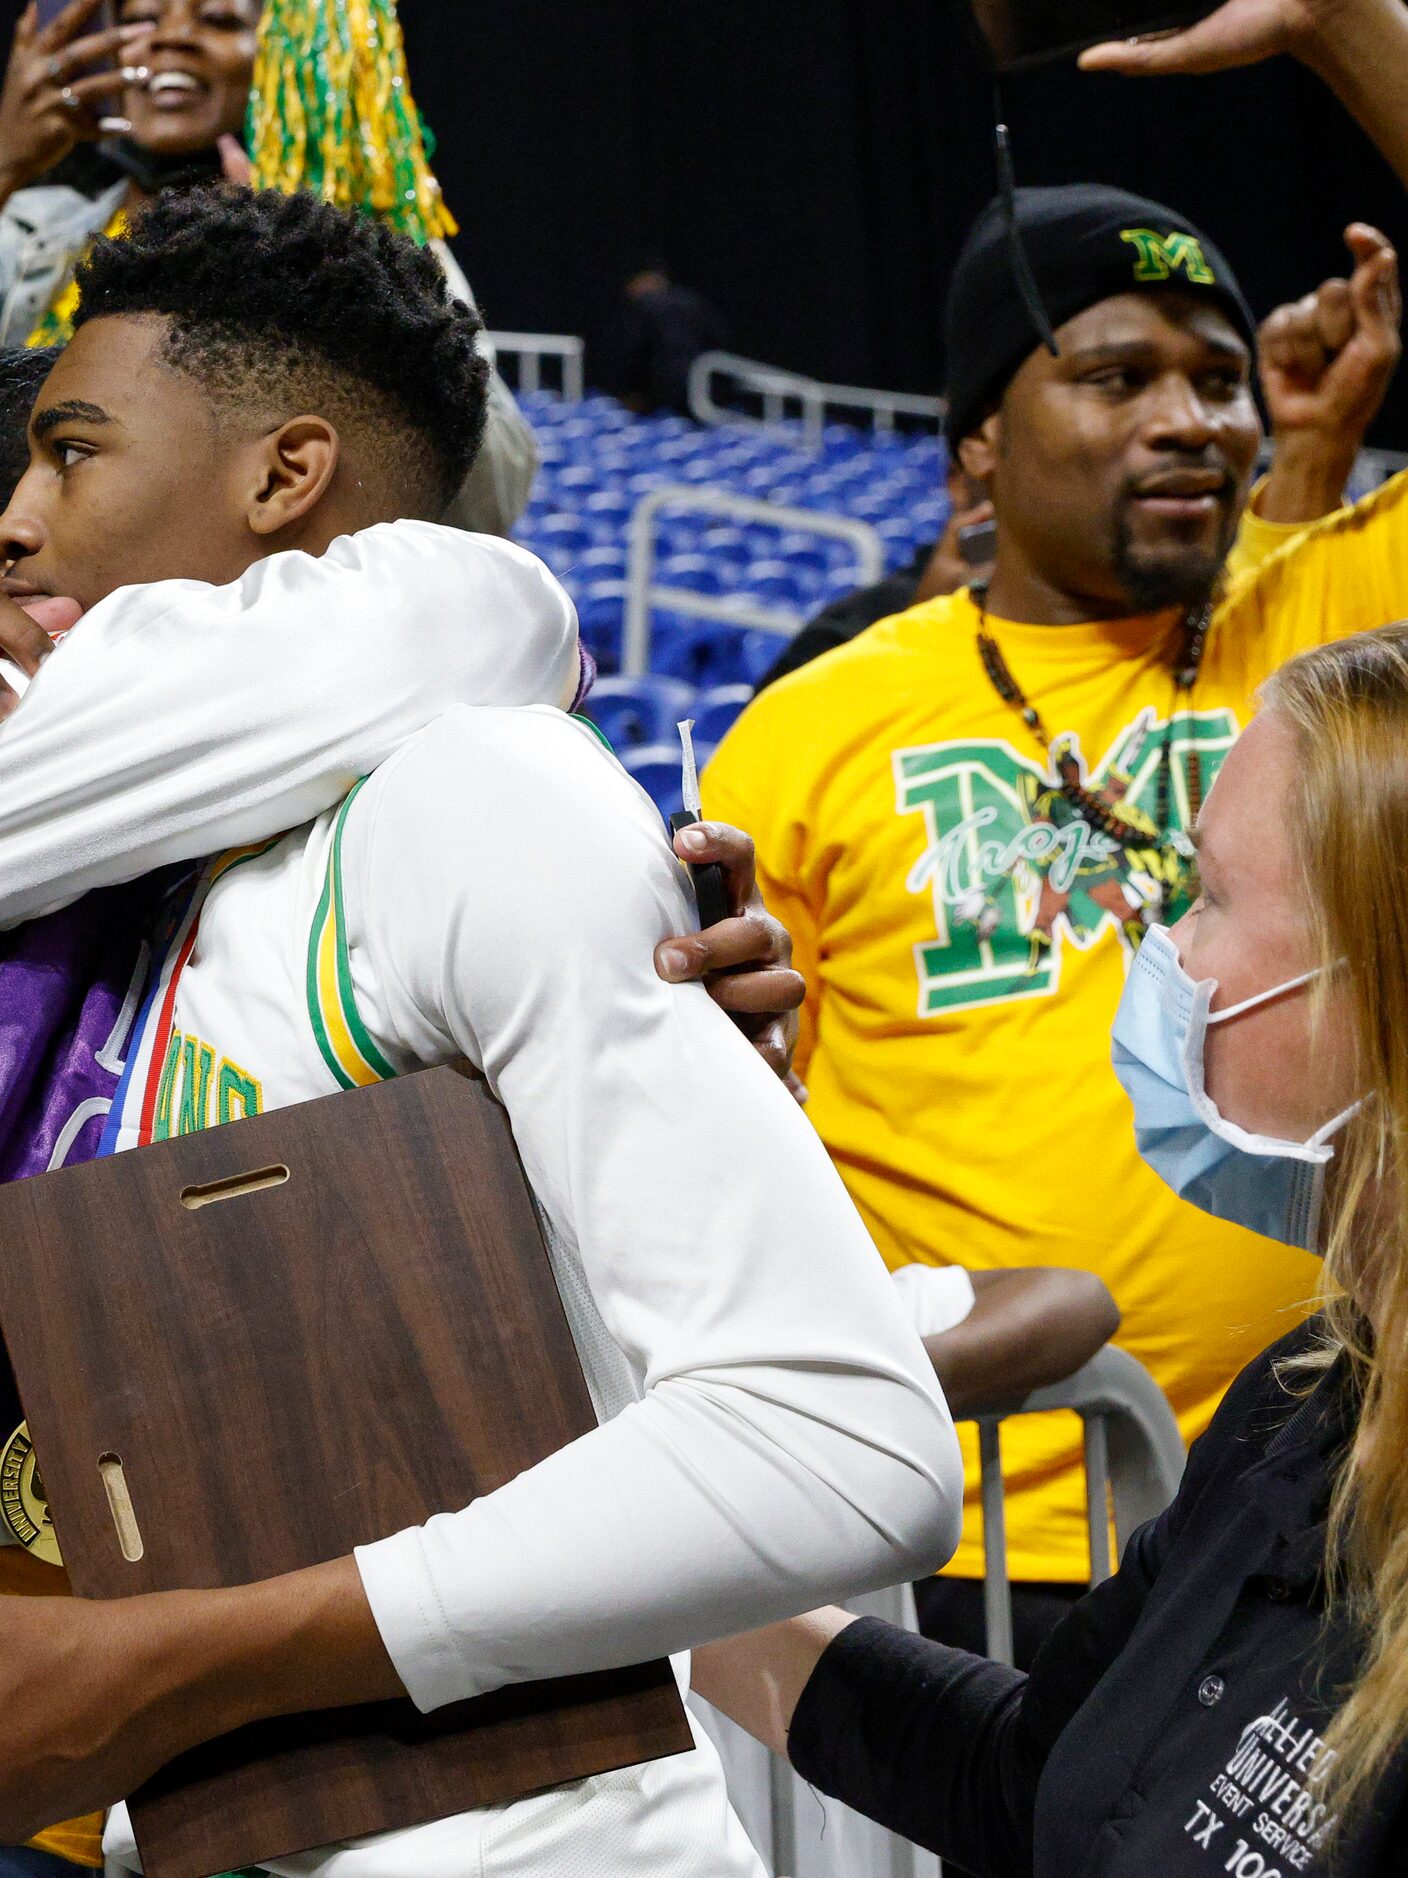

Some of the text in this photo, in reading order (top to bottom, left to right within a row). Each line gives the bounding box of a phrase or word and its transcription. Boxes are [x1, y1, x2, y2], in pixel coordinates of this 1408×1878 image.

[1119, 228, 1216, 285] M
[1, 1438, 38, 1544] UNIVERSITY
[1209, 1773, 1255, 1819] EVENT
[1183, 1799, 1225, 1850] TX
